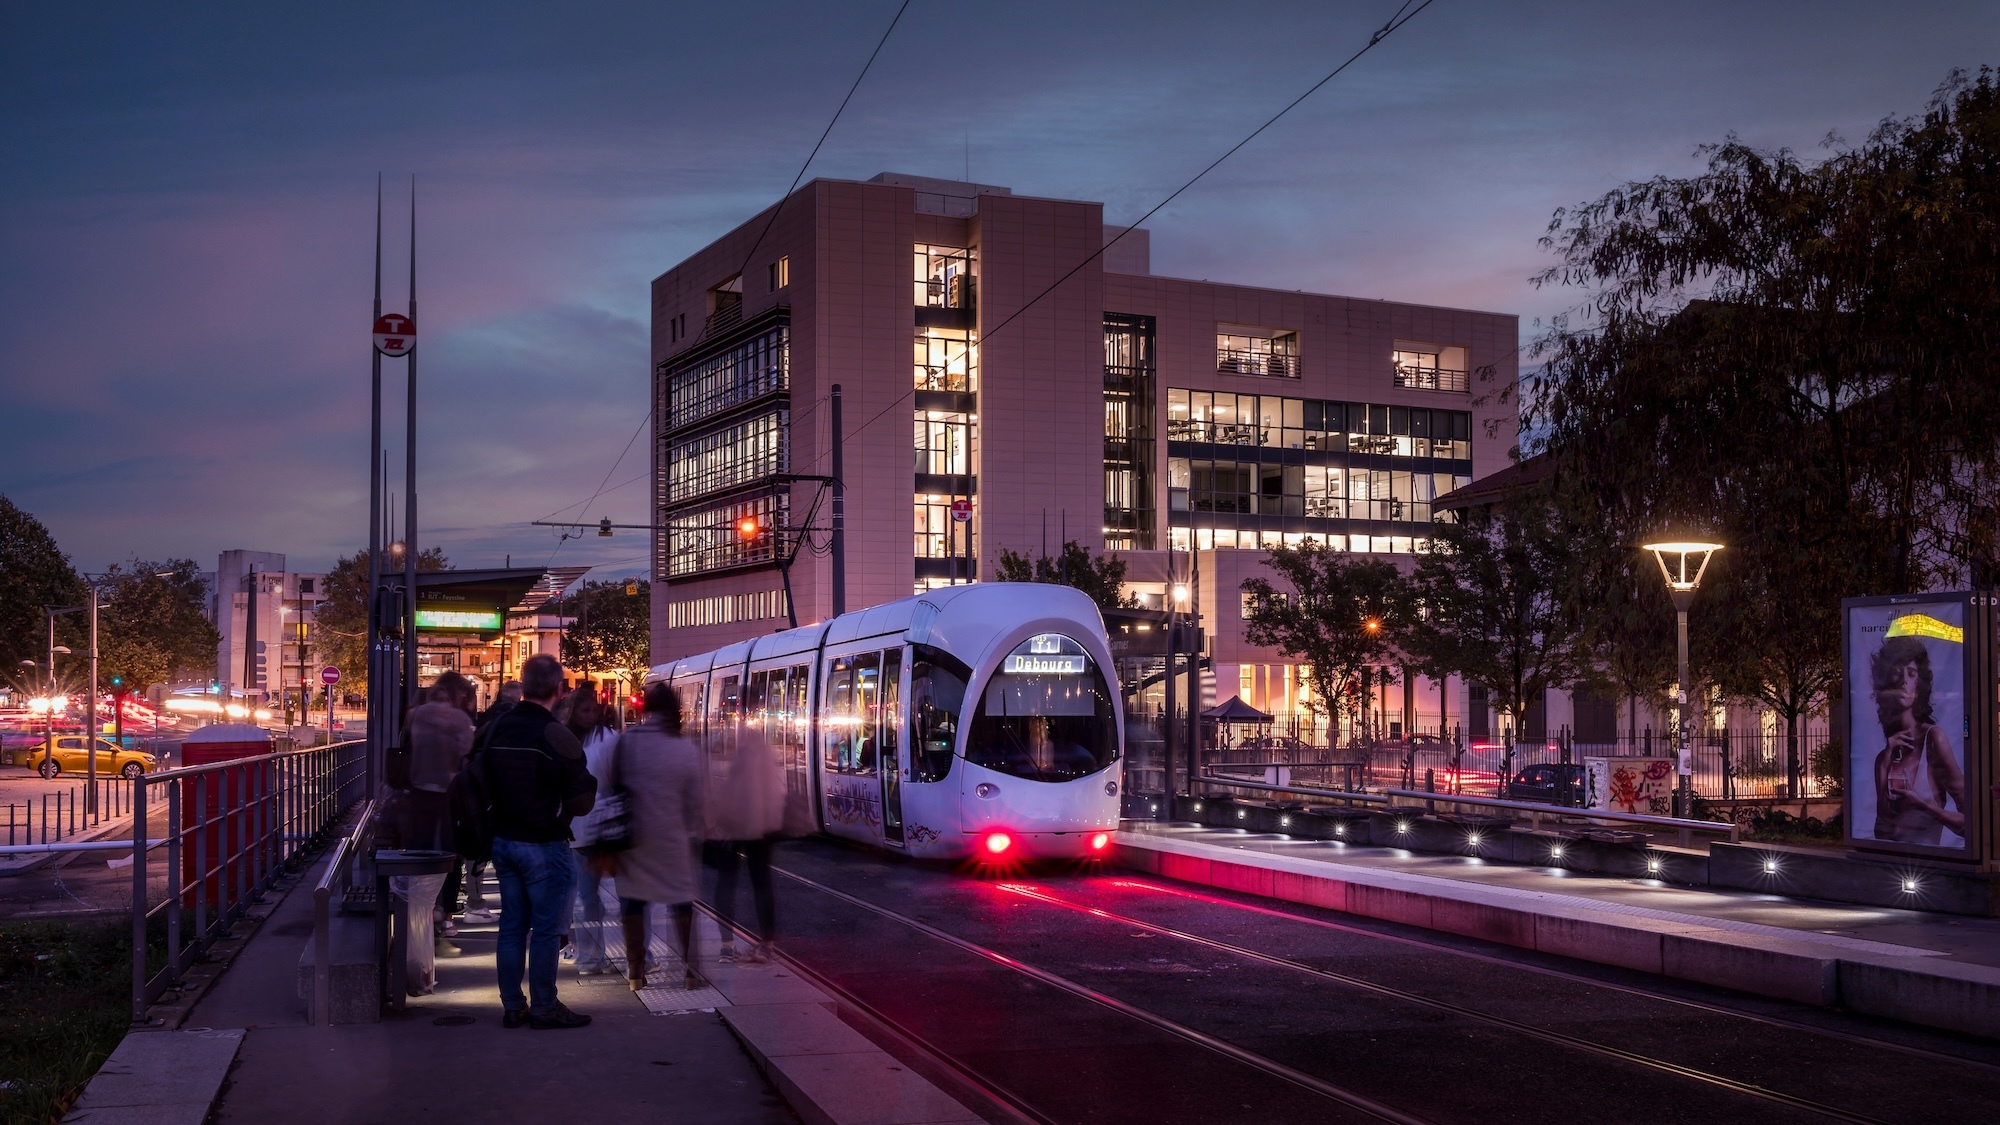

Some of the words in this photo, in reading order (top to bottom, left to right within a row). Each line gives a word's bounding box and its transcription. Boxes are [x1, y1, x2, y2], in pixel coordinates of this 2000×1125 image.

[385, 318, 405, 333] T
[384, 338, 404, 350] TCL
[957, 502, 967, 510] T
[420, 591, 426, 599] 1
[628, 586, 636, 594] 35
[1970, 596, 1976, 606] C
[1990, 596, 1998, 606] D
[1861, 624, 1893, 632] narci
[375, 643, 382, 651] A
[1037, 641, 1051, 653] T1
[1015, 655, 1072, 672] Debourg
